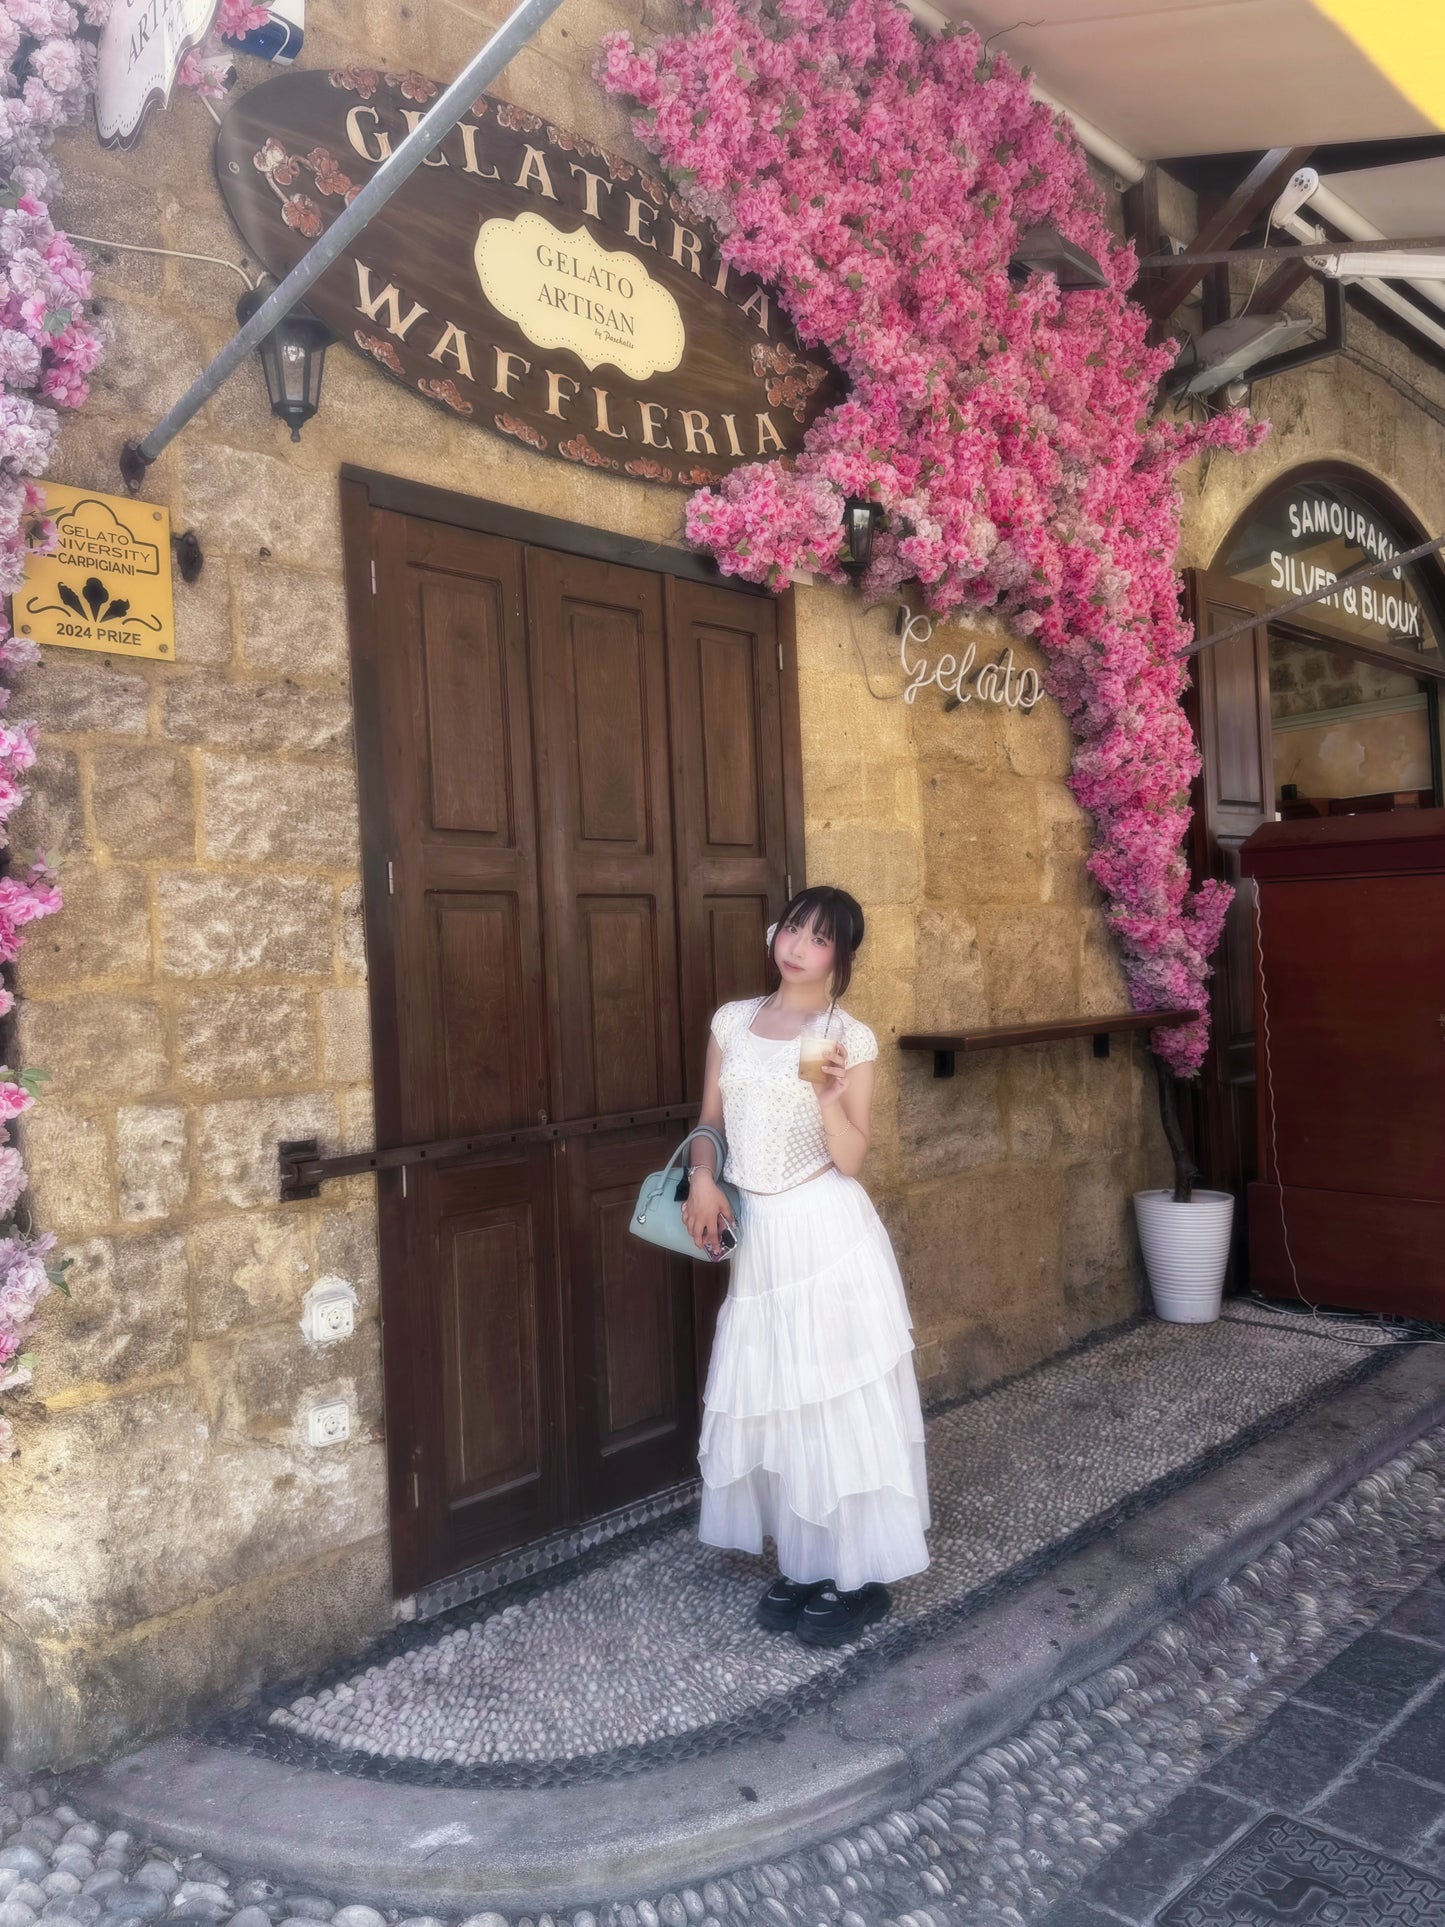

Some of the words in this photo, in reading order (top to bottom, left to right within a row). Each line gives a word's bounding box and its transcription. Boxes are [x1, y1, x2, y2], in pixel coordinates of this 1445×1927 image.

[536, 244, 634, 299] GELATO
[537, 283, 635, 336] ARTISAN
[594, 328, 603, 340] by
[353, 257, 787, 458] WAFFLERIA
[56, 537, 151, 564] NIVERSITY
[61, 524, 130, 546] GELATO
[1288, 500, 1402, 580] SAMOURAKIS
[58, 552, 136, 576] CARPIGIANI
[1270, 550, 1339, 609] SILVER
[1343, 585, 1358, 616] &
[1361, 585, 1420, 637] BIJOUX
[56, 622, 93, 639] 2024
[97, 628, 142, 646] PRIZE
[901, 604, 1046, 708] Gelato
